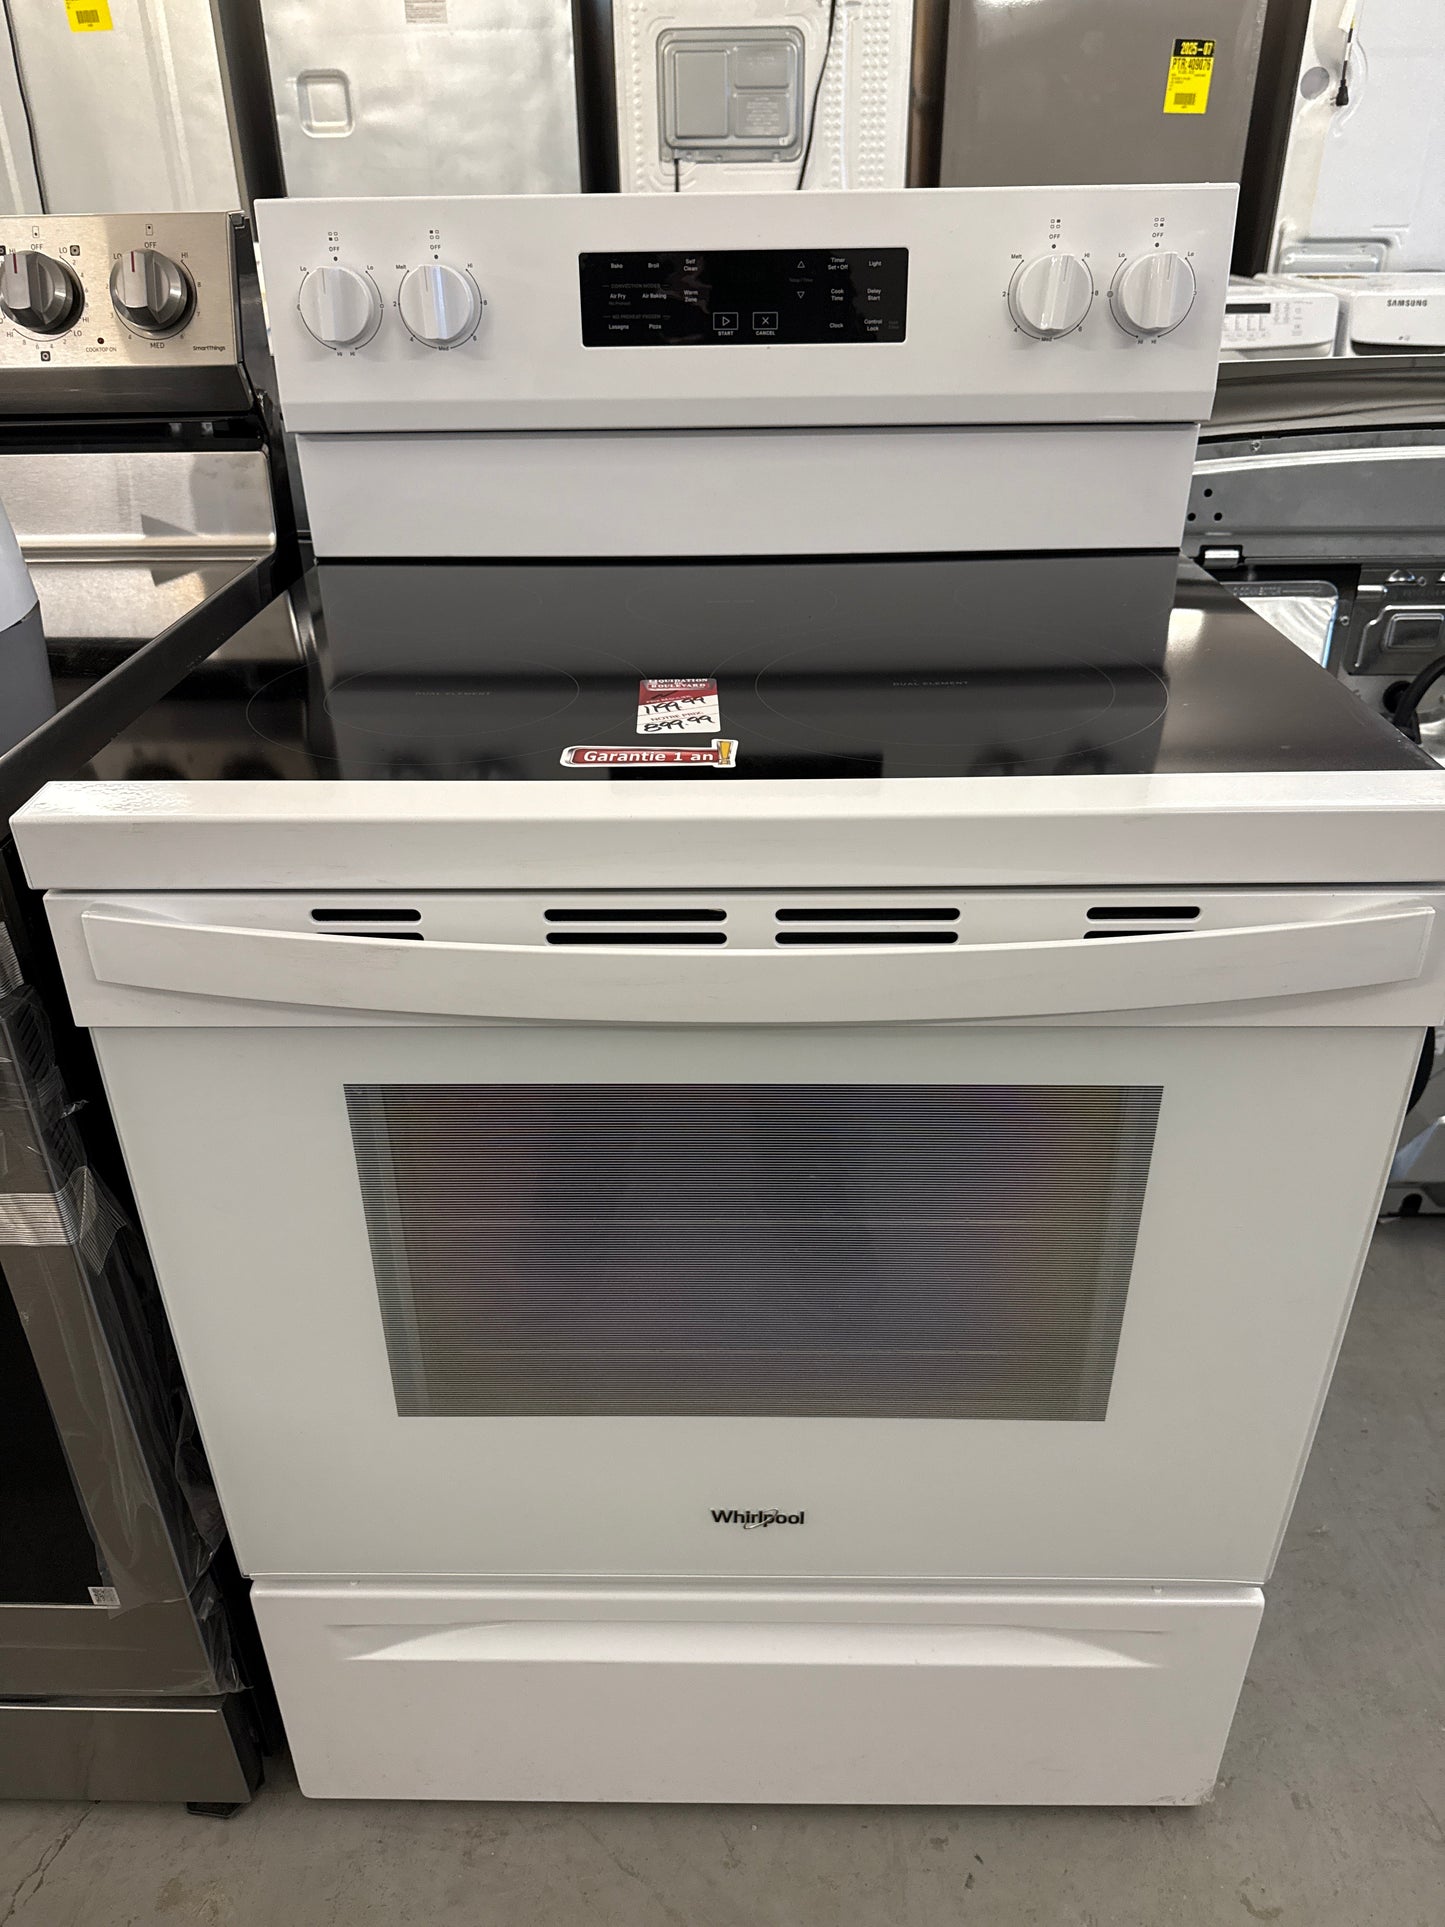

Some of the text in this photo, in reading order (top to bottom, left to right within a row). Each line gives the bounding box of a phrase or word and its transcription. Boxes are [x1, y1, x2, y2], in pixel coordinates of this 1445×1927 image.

[1387, 299, 1427, 307] SAMSUNG
[644, 715, 715, 732] 899.99
[650, 714, 681, 722] NOTRE
[584, 751, 666, 762] Garantie
[673, 752, 683, 761] 1
[690, 753, 713, 761] an
[711, 1510, 805, 1527] Whirlpool
